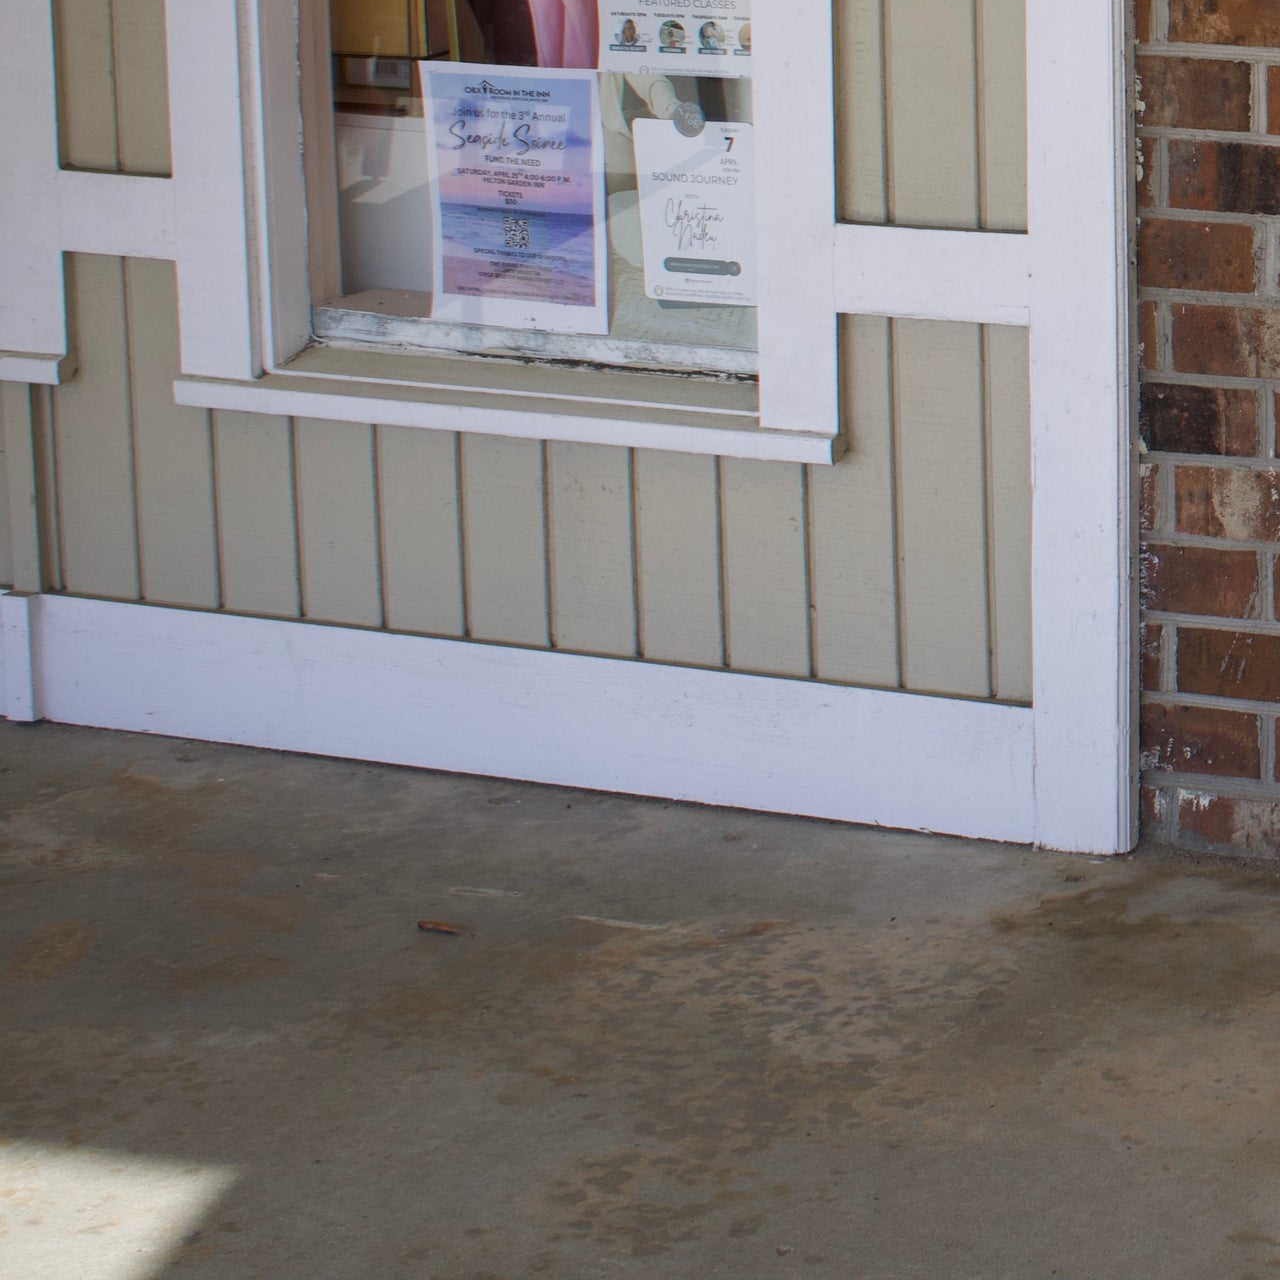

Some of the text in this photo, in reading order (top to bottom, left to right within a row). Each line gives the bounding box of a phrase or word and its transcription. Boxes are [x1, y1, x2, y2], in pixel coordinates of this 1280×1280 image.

[693, 0, 737, 10] CLASSES
[489, 87, 512, 96] ROOM
[451, 106, 471, 117] Join
[473, 109, 485, 118] us
[487, 109, 500, 119] for
[501, 110, 516, 120] the
[532, 111, 566, 123] Annual
[724, 136, 735, 153] 7
[485, 155, 541, 167] FUND THE NEED
[652, 172, 739, 186] SOUND JOURNEY
[498, 190, 524, 199] TICKETS
